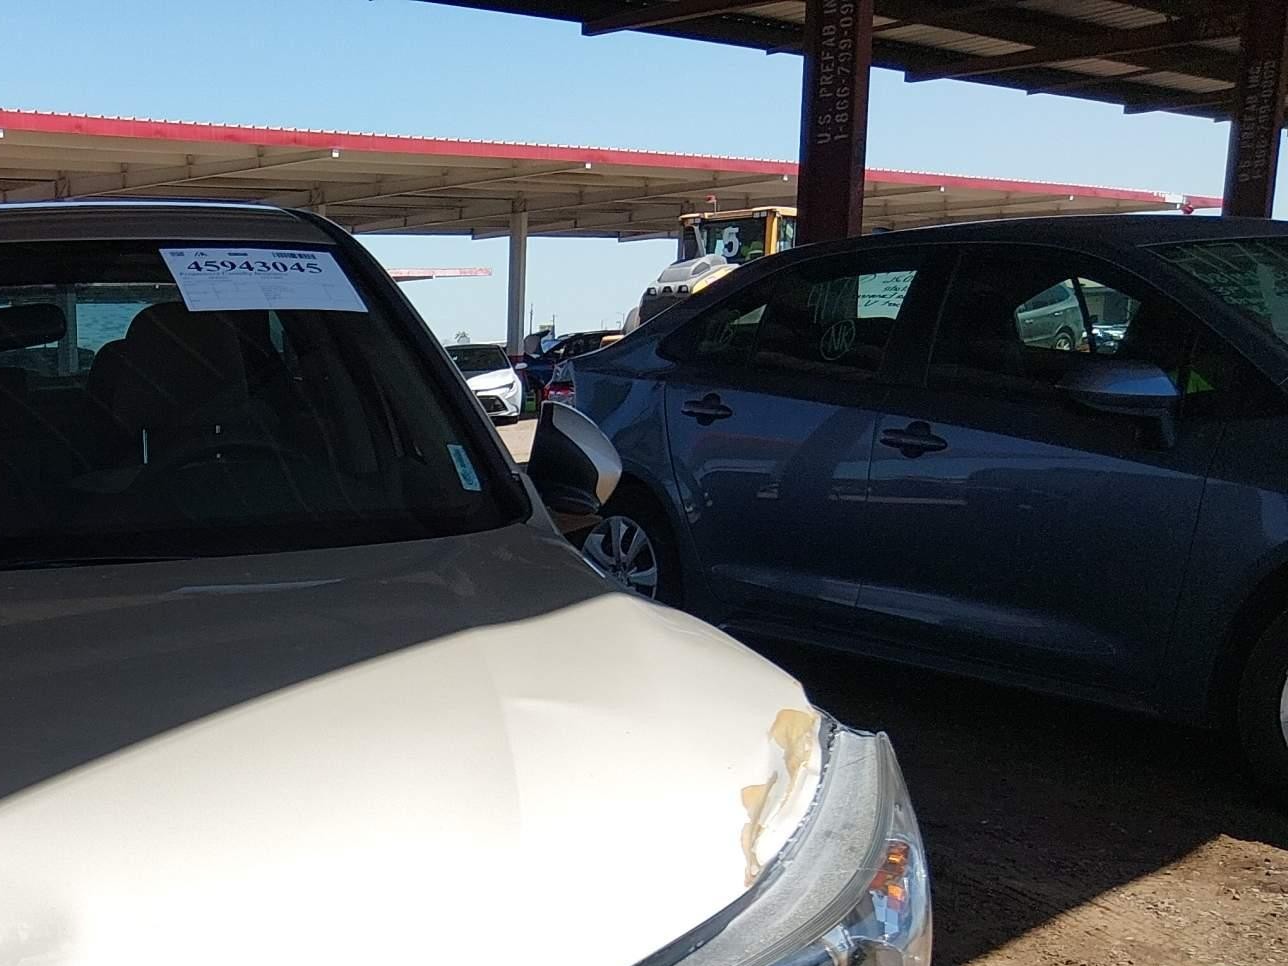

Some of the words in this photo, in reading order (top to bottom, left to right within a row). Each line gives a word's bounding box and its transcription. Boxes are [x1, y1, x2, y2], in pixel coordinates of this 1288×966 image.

[819, 24, 837, 97] PREFAB
[834, 0, 855, 141] 1-866-799-09
[187, 259, 323, 275] 45943045
[722, 226, 740, 258] 5
